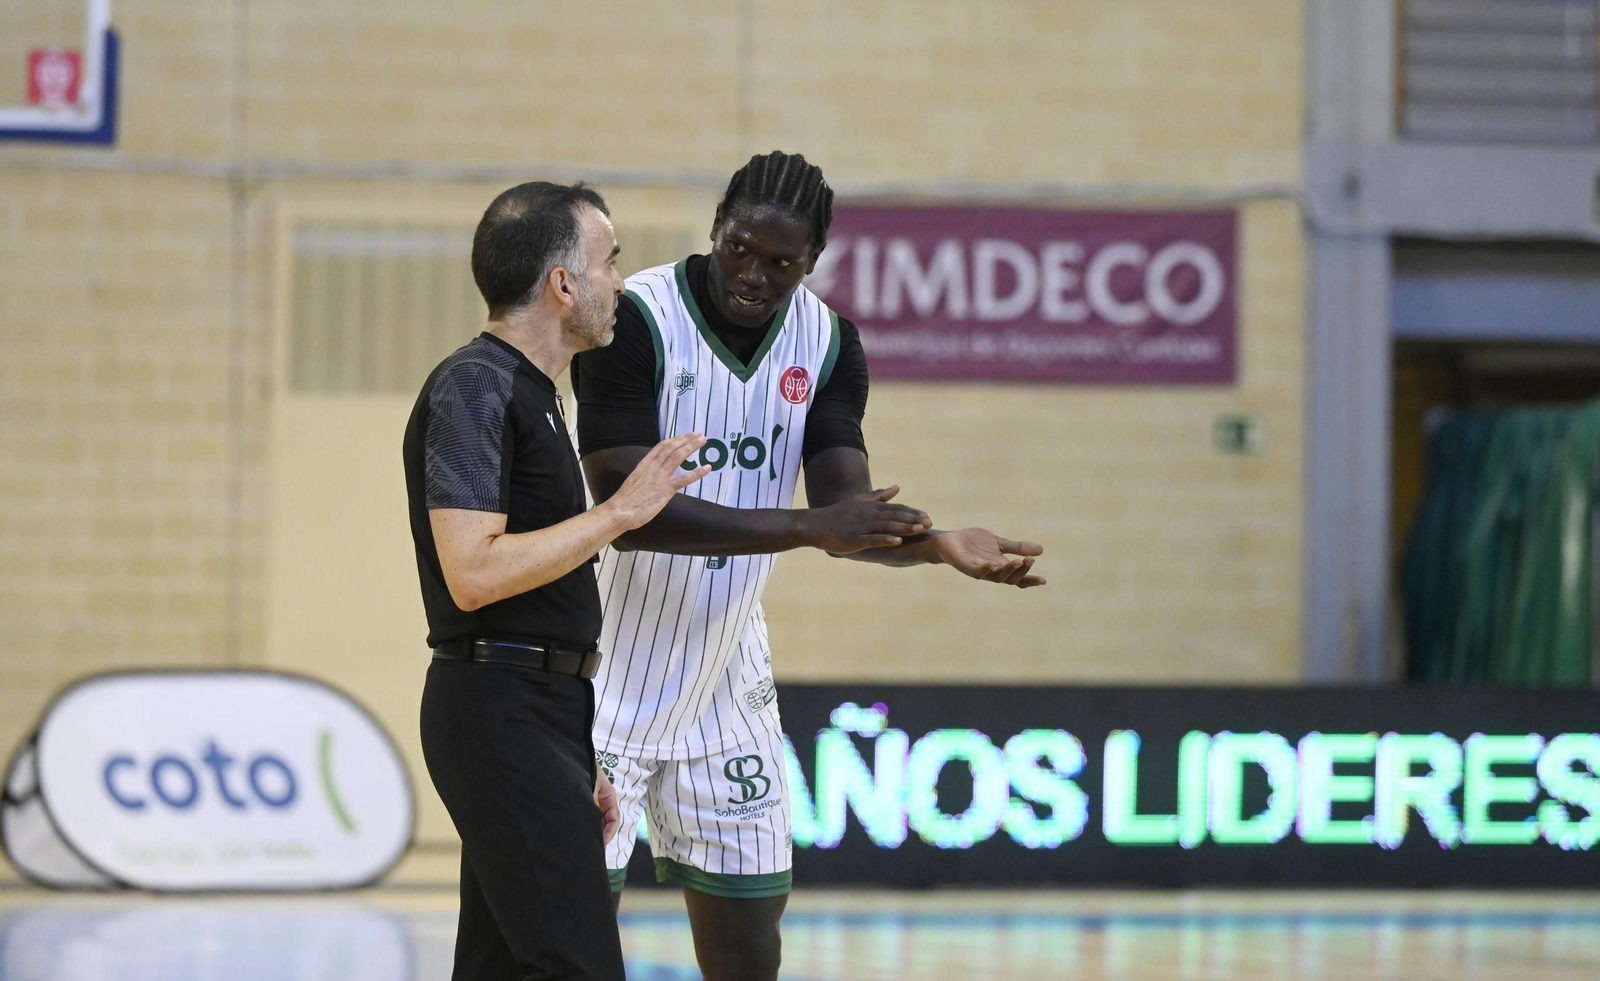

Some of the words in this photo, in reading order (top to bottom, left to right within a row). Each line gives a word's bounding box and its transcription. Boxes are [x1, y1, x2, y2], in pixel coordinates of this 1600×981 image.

[853, 237, 1225, 326] IMDECO
[103, 736, 298, 811] coto
[714, 798, 782, 819] SohoBoutique
[1103, 731, 1600, 849] LIDERES
[739, 811, 766, 822] HOTELS
